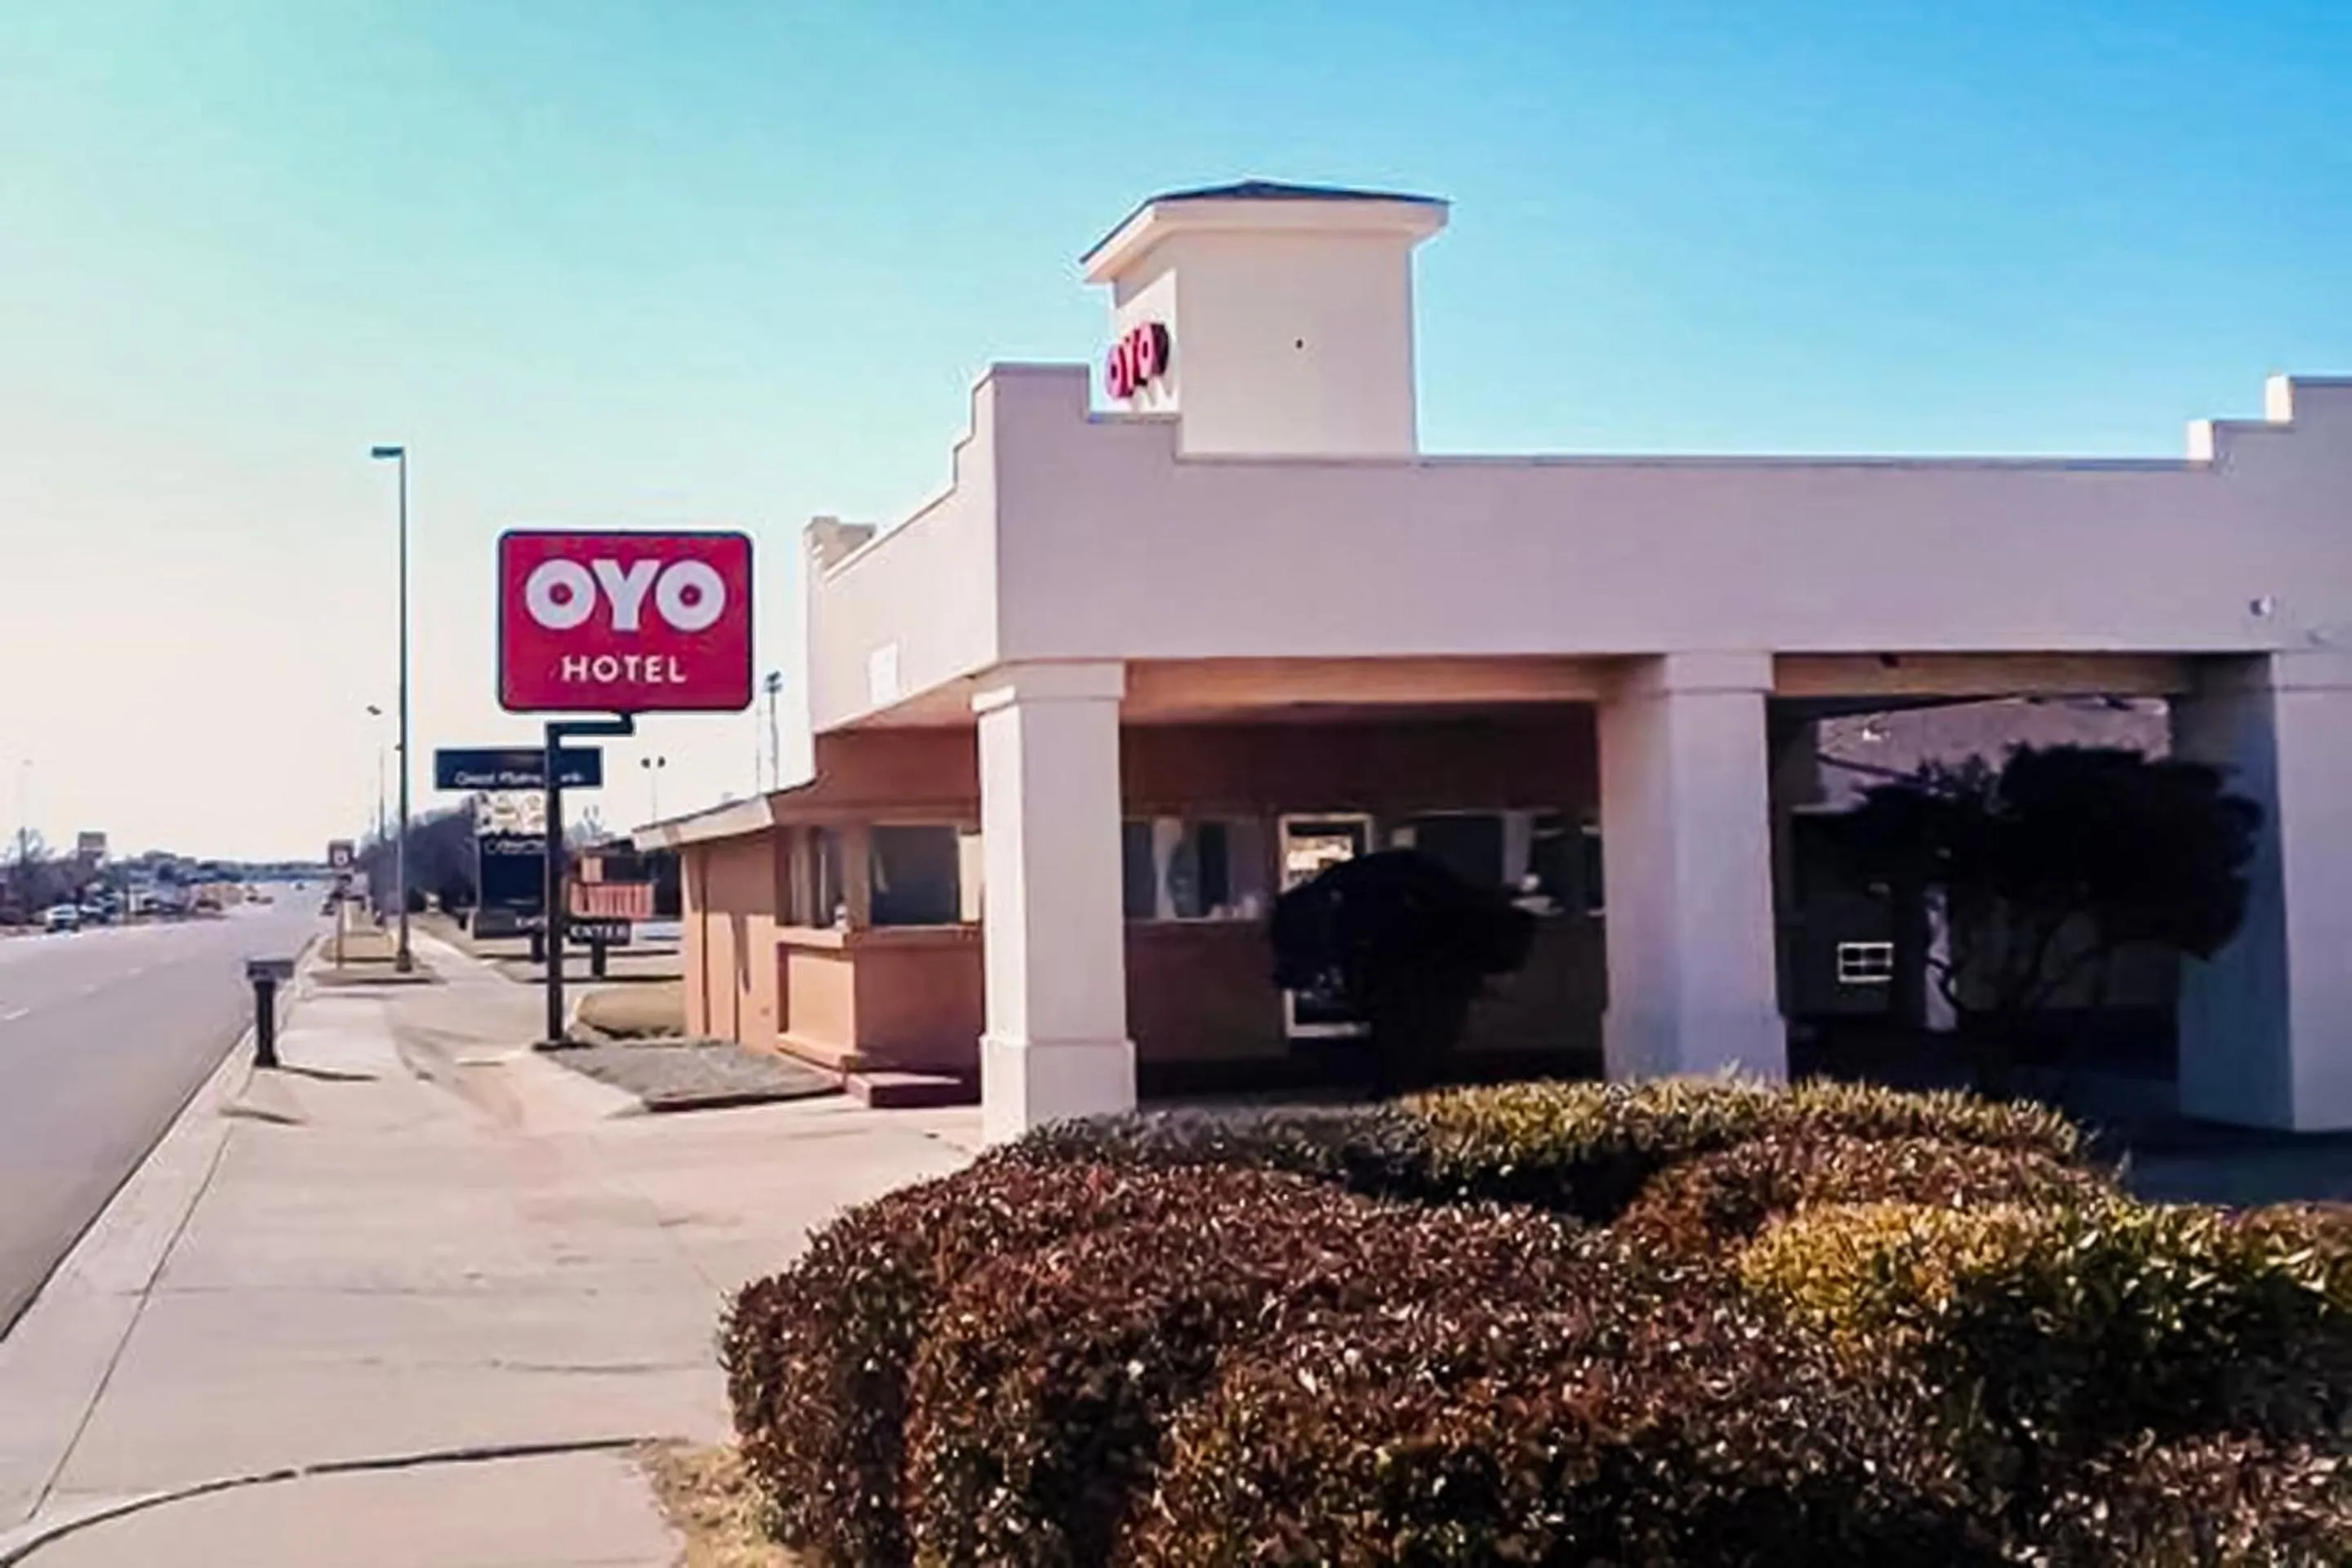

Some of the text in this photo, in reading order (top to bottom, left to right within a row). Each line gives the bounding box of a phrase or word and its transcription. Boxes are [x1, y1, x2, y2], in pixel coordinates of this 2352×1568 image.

[1105, 321, 1169, 399] OYO
[525, 559, 726, 632] OYO
[561, 655, 688, 684] HOTEL
